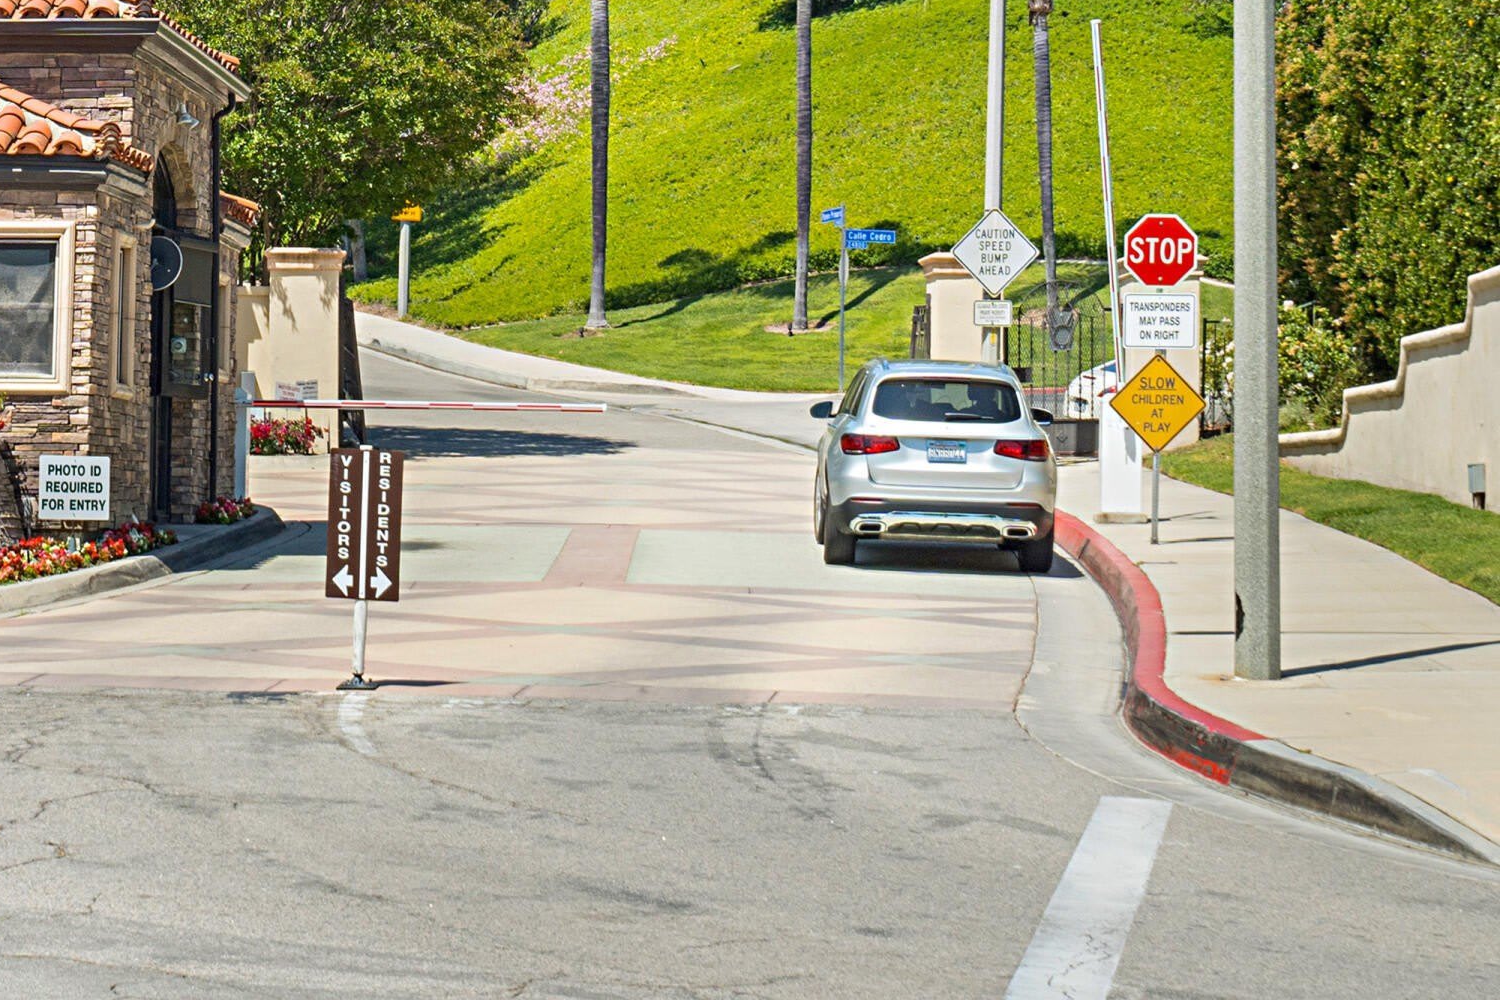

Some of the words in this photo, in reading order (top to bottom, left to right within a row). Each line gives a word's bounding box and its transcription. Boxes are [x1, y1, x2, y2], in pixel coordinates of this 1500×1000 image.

[848, 231, 867, 240] Calle
[869, 232, 892, 241] Cedro
[975, 229, 1015, 239] CAUTION
[979, 241, 1012, 251] SPEED
[1129, 237, 1193, 265] STOP
[981, 253, 1009, 264] BUMP
[979, 266, 1011, 276] AHEAD
[1130, 302, 1190, 312] TRANSPONDERS
[1139, 317, 1157, 326] MAY
[1160, 317, 1181, 326] PASS
[1139, 331, 1152, 340] ON
[1155, 331, 1180, 340] RIGHT
[1140, 377, 1176, 389] SLOW
[1132, 394, 1184, 405] CHILDREN
[1151, 409, 1164, 418] AT
[1143, 422, 1171, 432] PLAY
[48, 464, 86, 476] PHOTO
[90, 465, 102, 476] ID
[45, 481, 103, 493] REQUIRED
[41, 499, 65, 510] FOR
[69, 499, 106, 511] ENTRY
[337, 454, 353, 559] VISITORS
[376, 452, 392, 567] RESIDENTS
